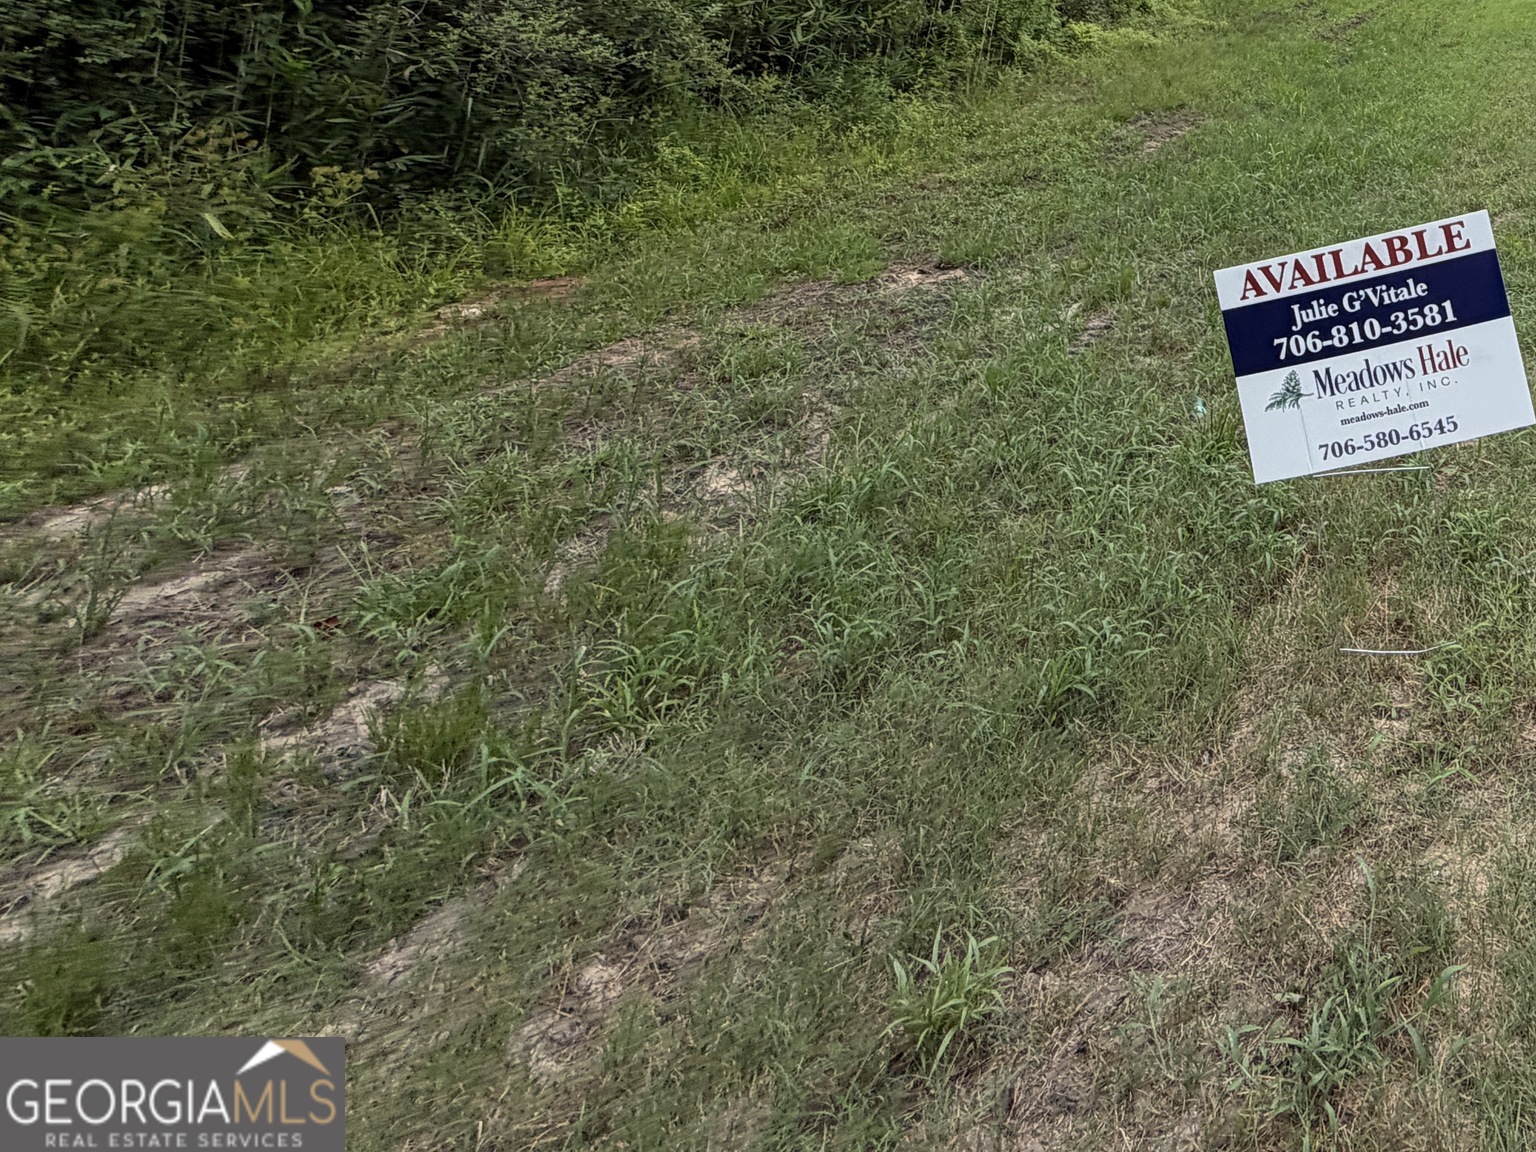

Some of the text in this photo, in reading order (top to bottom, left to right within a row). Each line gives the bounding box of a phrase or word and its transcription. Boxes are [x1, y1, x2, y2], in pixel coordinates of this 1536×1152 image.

[1240, 221, 1471, 301] AVAILABLE
[1273, 300, 1457, 360] 706-810-3581
[1291, 278, 1428, 331] Julie G'Vitale
[1312, 340, 1470, 399] Meadows Hale
[1336, 376, 1458, 410] REALTY, INC.
[1318, 415, 1458, 461] 706-580-6545
[1340, 400, 1429, 426] meadows-hale.com
